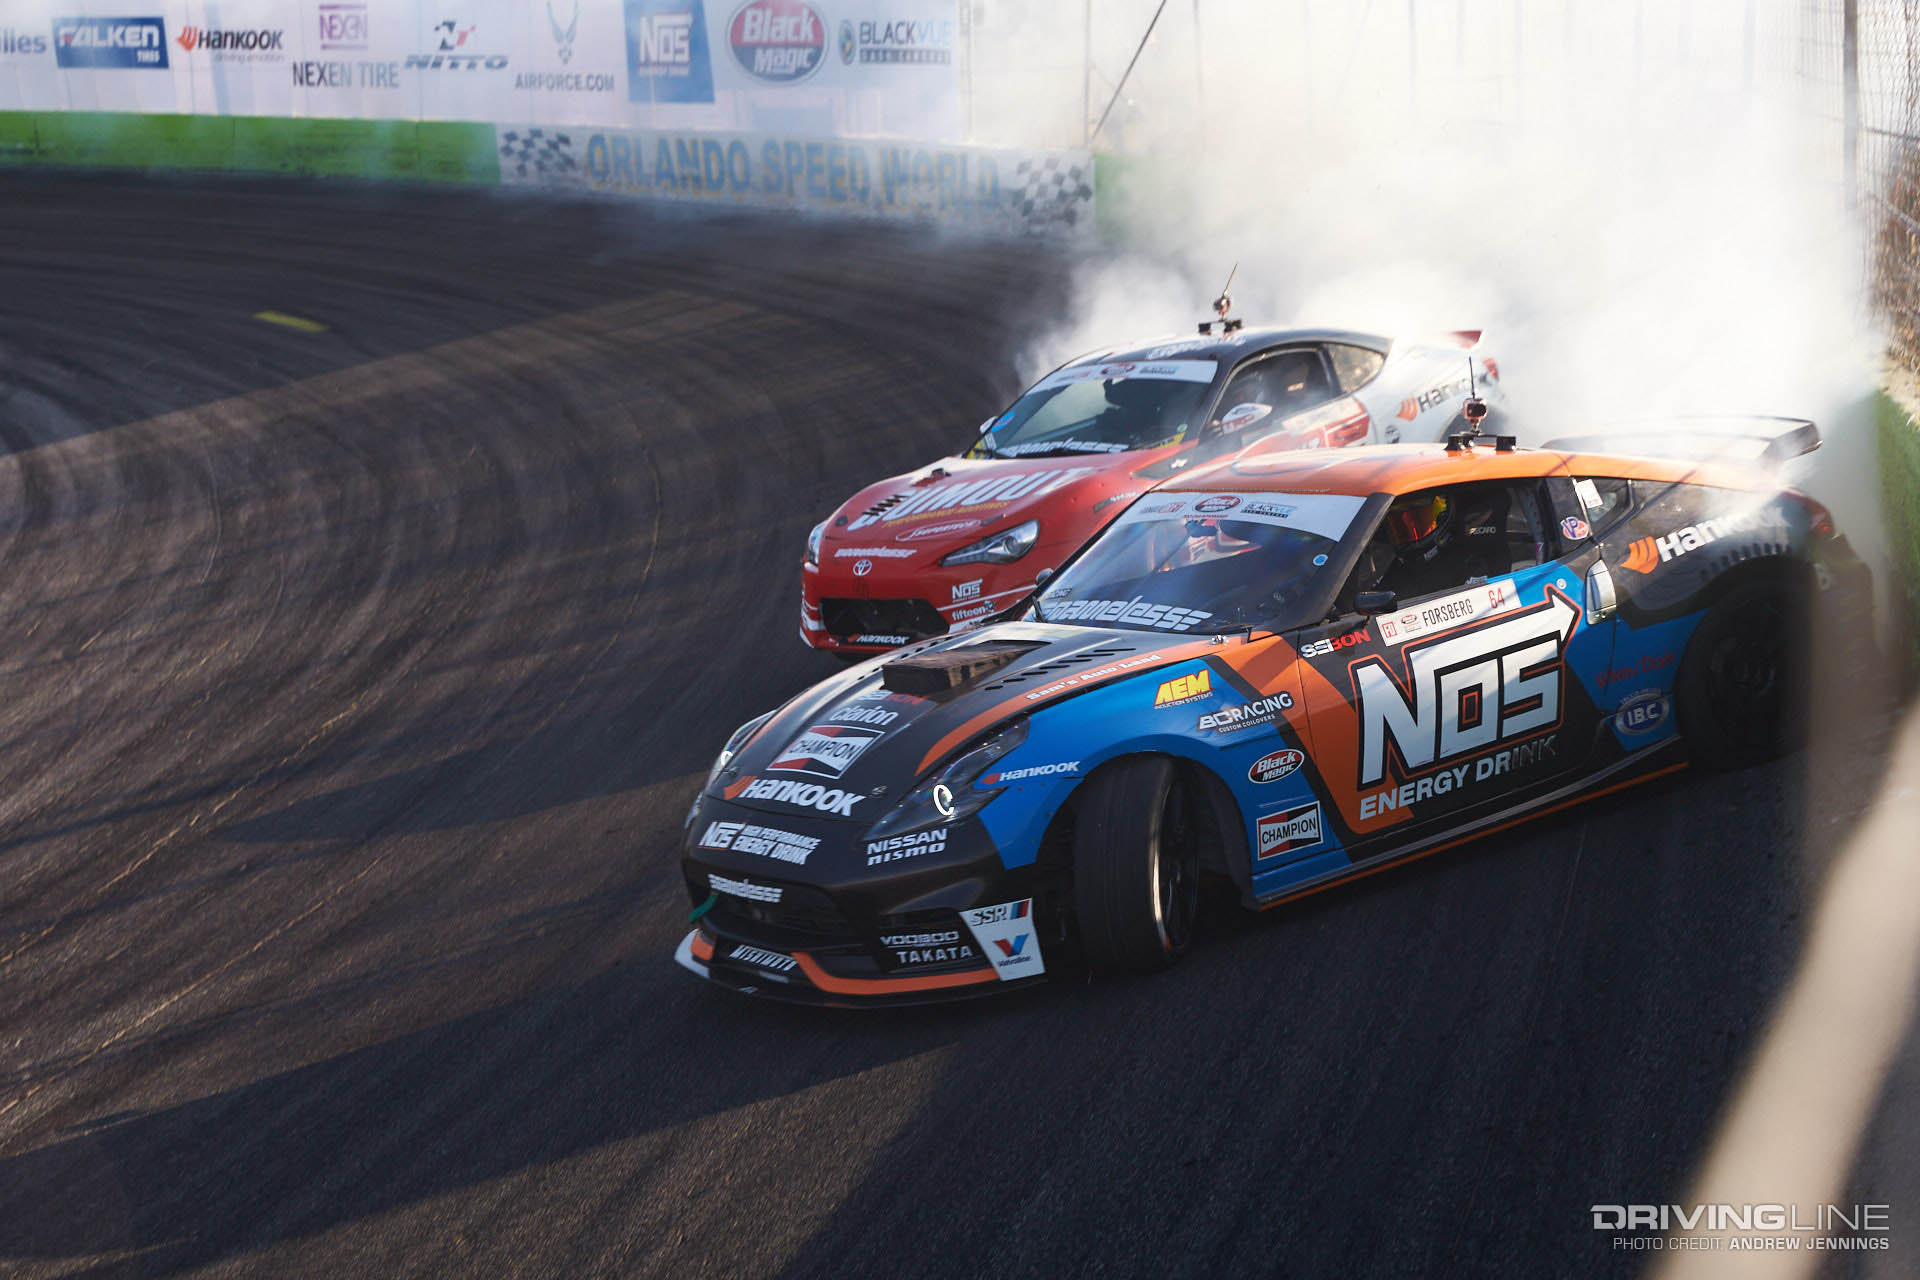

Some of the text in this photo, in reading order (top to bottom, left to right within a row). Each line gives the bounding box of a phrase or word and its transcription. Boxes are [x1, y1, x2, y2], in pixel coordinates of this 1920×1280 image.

[59, 25, 160, 48] FALKEN
[639, 13, 692, 65] NOS
[742, 7, 816, 44] Black
[859, 21, 951, 45] BLACKVUE
[404, 54, 509, 70] NITTO
[753, 47, 814, 75] Magic
[292, 62, 400, 88] NEXEN TIRE
[515, 73, 615, 92] AIRFORCE.COM
[586, 133, 1003, 217] ORLANDO SPEED WORLD
[952, 578, 983, 600] NOS
[1043, 595, 1213, 631] nameless
[1422, 599, 1474, 626] FORSBERG
[1488, 587, 1505, 609] 64
[1300, 629, 1371, 658] SEIBON
[1026, 654, 1161, 701] Sam's Auto Land
[1154, 668, 1213, 706] AEM
[1357, 597, 1574, 784] NOS
[1218, 714, 1276, 733] CUSTOM COILOVERS
[788, 738, 862, 760] CHAMPION
[1257, 751, 1296, 773] Black
[1262, 763, 1296, 782] Magic
[1359, 735, 1557, 820] ENERGY DRINK
[698, 821, 747, 848] NOS
[867, 828, 948, 855] NISSAN
[1262, 818, 1317, 845] CHAMPION
[769, 843, 814, 865] DRINK
[971, 905, 1008, 927] SSR
[896, 945, 973, 964] TAKATA
